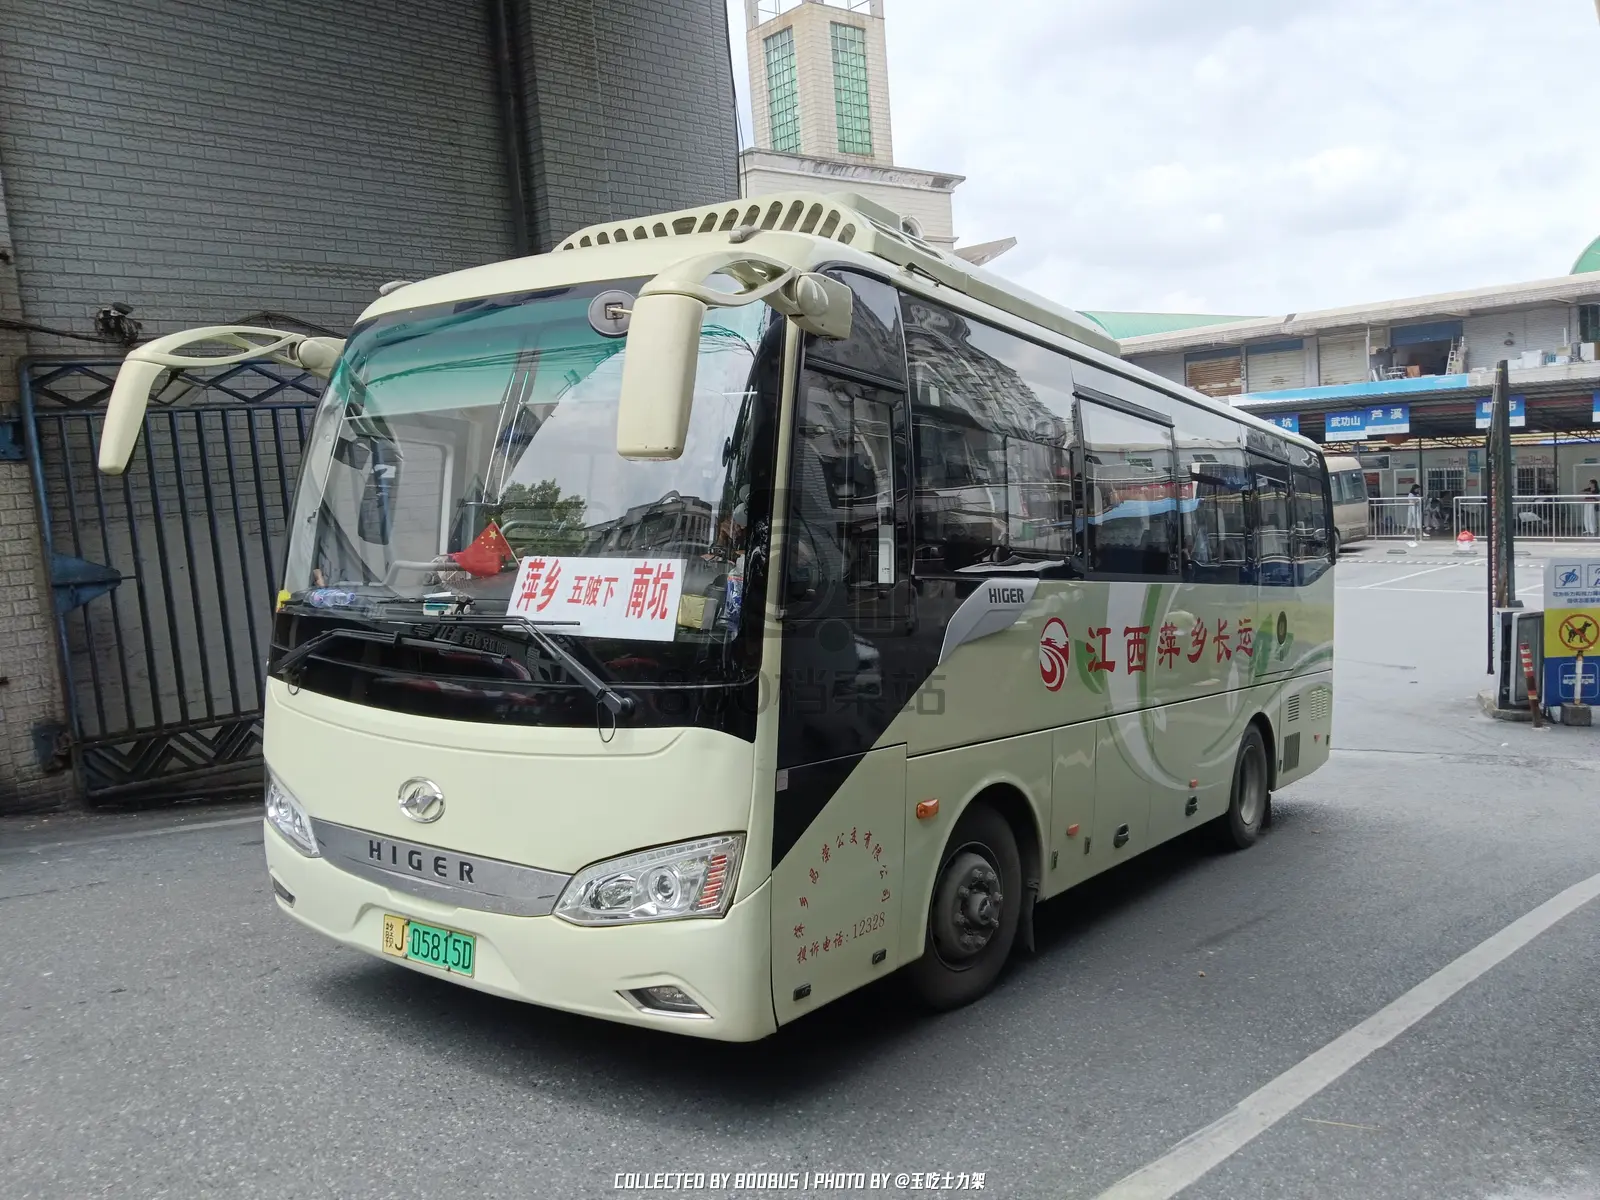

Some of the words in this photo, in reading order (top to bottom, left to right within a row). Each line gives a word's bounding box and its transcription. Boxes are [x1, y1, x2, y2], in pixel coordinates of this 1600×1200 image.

[1330, 416, 1361, 427] 武功山
[1370, 408, 1404, 420] 芦溪
[516, 558, 562, 612] 萍乡
[567, 575, 619, 607] 五陂下
[625, 561, 675, 620] 南坑
[988, 587, 1025, 604] HIGER
[1086, 618, 1254, 676] 江西萍乡长运
[368, 839, 475, 884] HIGER
